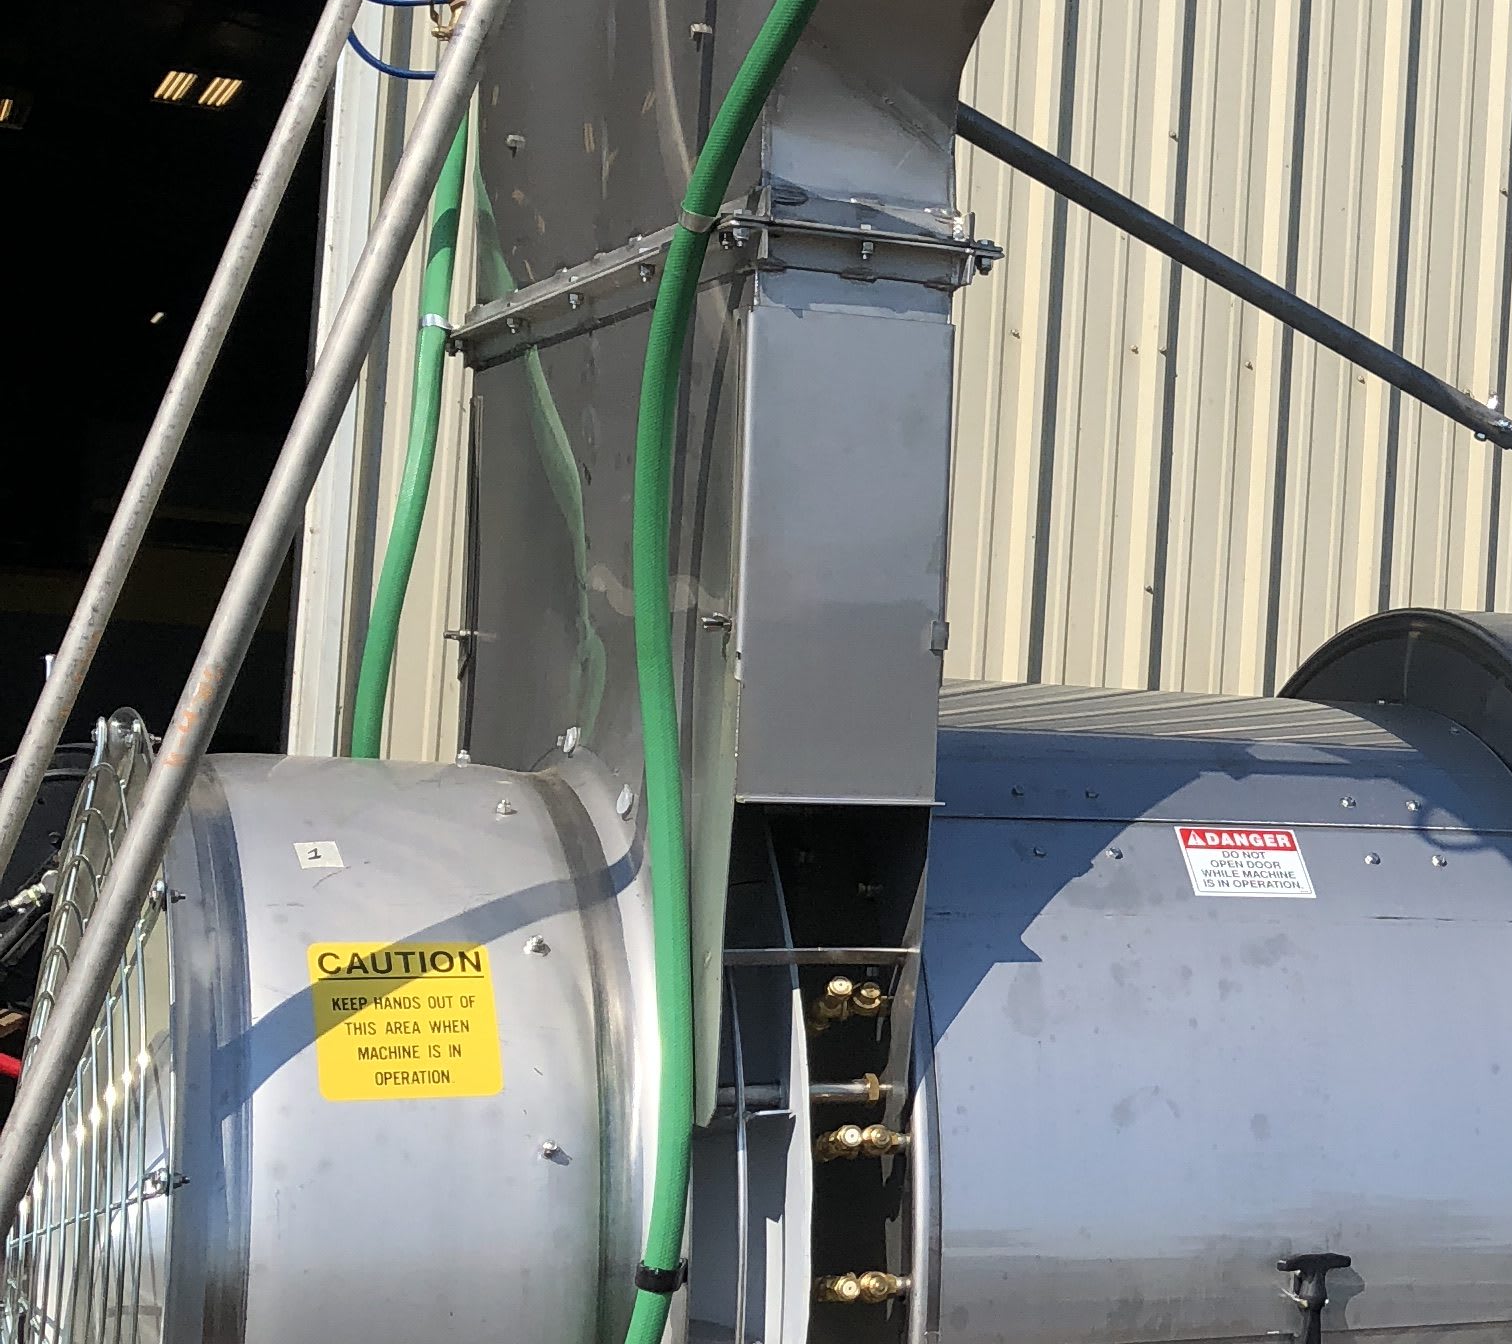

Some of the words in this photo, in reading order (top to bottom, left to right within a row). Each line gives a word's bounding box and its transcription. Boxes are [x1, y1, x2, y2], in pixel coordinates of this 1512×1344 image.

[1204, 831, 1292, 848] DANGER
[307, 847, 322, 860] 1
[1222, 850, 1239, 859] DO
[1243, 851, 1266, 860] NOT
[1210, 860, 1243, 869] OPEN
[1246, 860, 1281, 869] DOOR
[1201, 869, 1240, 878] WHILE
[1243, 870, 1297, 879] MACHINE
[1203, 879, 1215, 888] IS
[1218, 879, 1230, 888] IN
[317, 950, 482, 975] CAUTION
[331, 996, 368, 1011] KEEP
[374, 996, 421, 1010] HANDS
[427, 995, 453, 1009] OUT
[460, 995, 476, 1009] OF
[344, 1021, 377, 1036] THIS
[385, 1020, 421, 1035] AREA
[429, 1019, 470, 1034] WHEN
[357, 1045, 420, 1061] MACHINE
[428, 1044, 441, 1058] IS
[449, 1044, 462, 1058] IN
